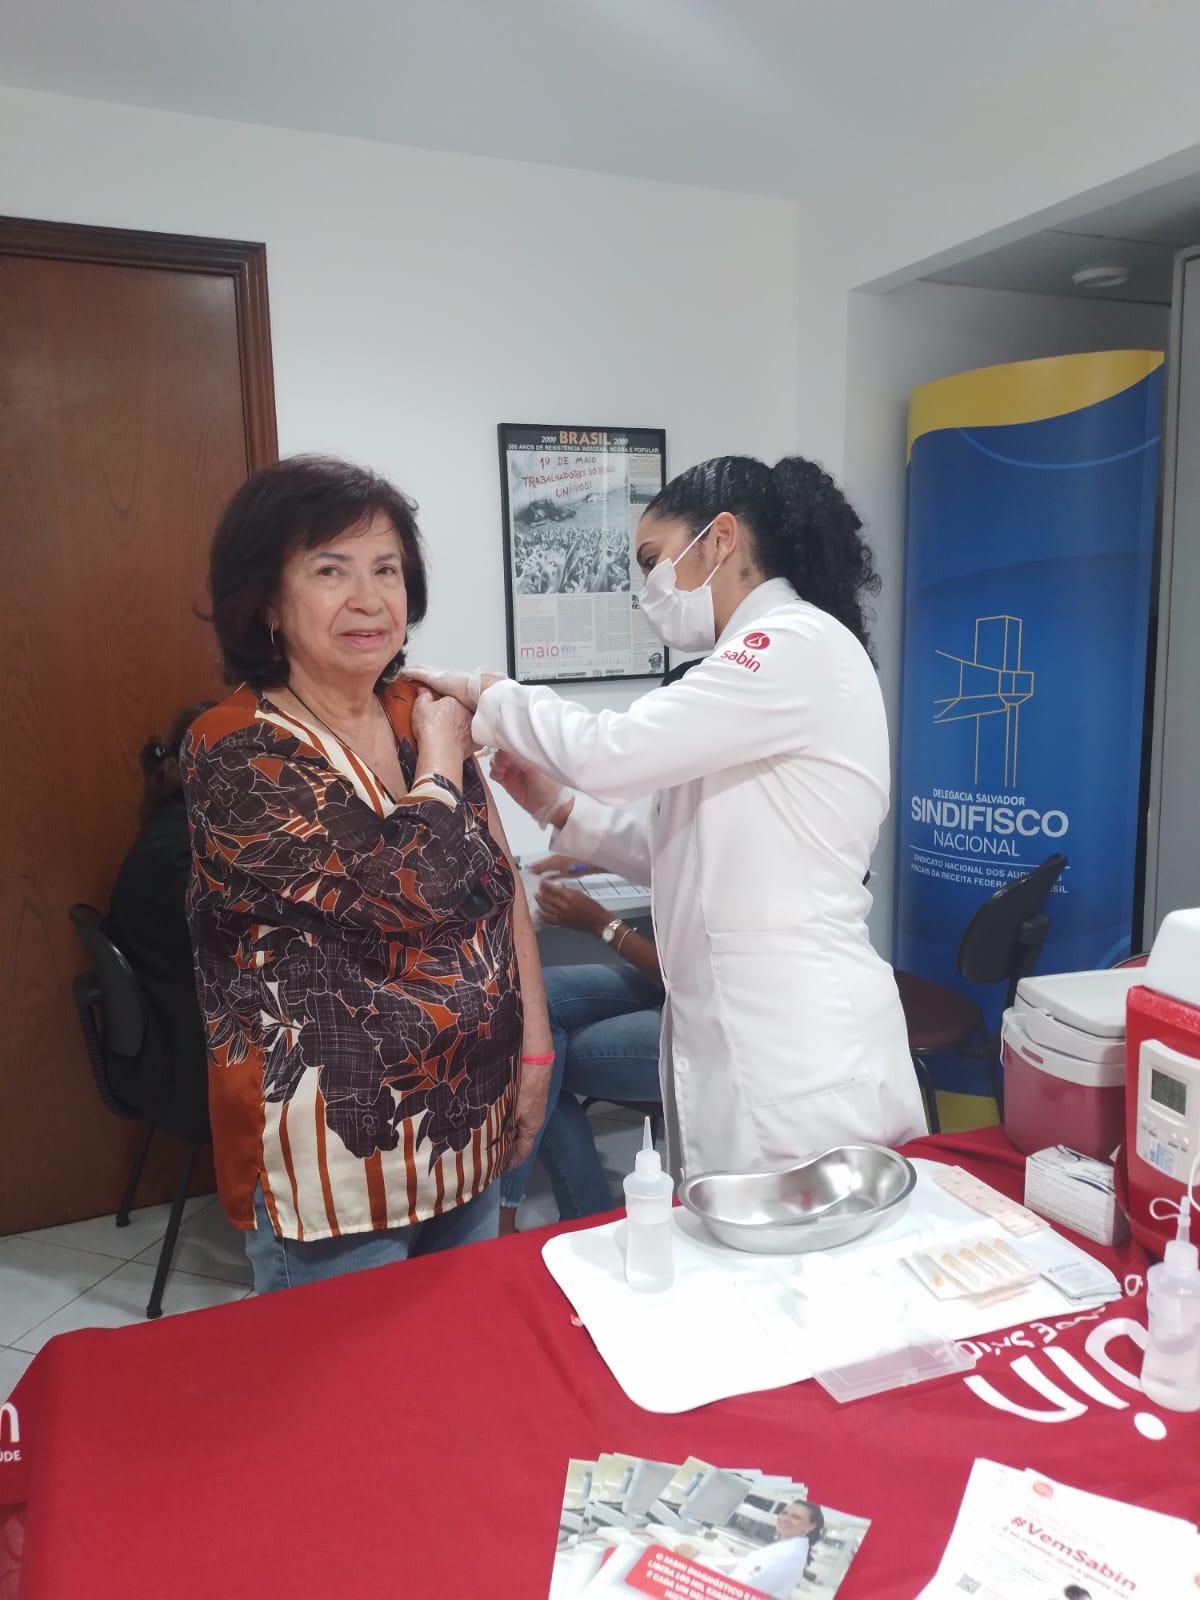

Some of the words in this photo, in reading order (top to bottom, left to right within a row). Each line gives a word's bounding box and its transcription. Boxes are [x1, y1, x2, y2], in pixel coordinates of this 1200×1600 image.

[559, 431, 611, 446] BRASIL
[557, 457, 569, 465] DE
[575, 456, 597, 464] MAIO
[520, 643, 559, 659] maio
[721, 650, 761, 672] sabin
[933, 788, 973, 803] DELEGACIA
[975, 793, 1025, 806] SALVADOR
[911, 796, 1069, 837] SINDIFISCO
[933, 830, 1020, 857] NACIONAL
[911, 863, 930, 875] FISCAIS
[931, 868, 940, 877] DA
[941, 871, 972, 884] RECEITA
[974, 877, 1008, 889] FEDERA
[913, 853, 943, 868] SINDICATO
[945, 862, 984, 875] NACIONAL
[986, 868, 1005, 877] DOS
[655, 1552, 664, 1562] O
[1011, 1515, 1138, 1592] #VemSabin
